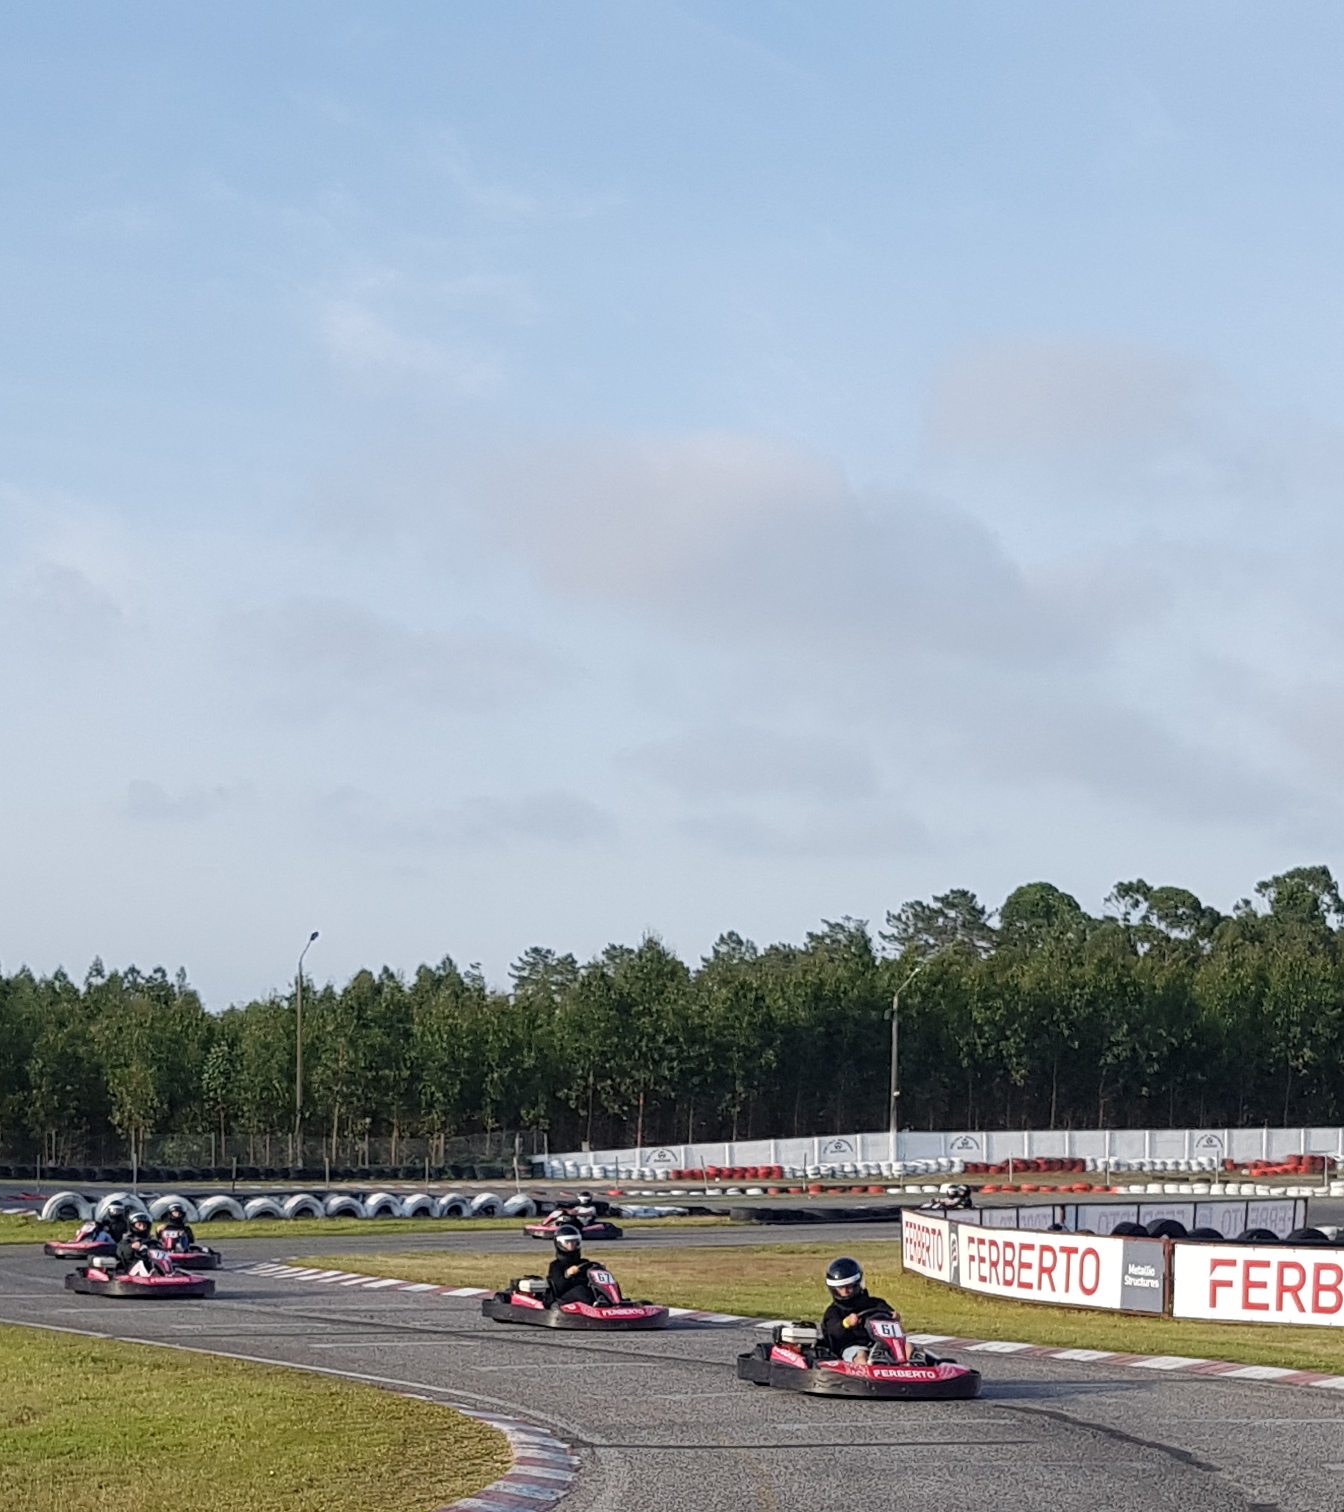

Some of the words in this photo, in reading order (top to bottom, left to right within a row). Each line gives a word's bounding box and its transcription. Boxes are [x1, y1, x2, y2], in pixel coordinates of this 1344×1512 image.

[905, 1221, 944, 1272] FERBERTO
[967, 1236, 1101, 1296] FERBERTO
[1124, 1274, 1160, 1288] Structures
[881, 1324, 898, 1338] 61
[873, 1369, 937, 1379] FERBERTO
